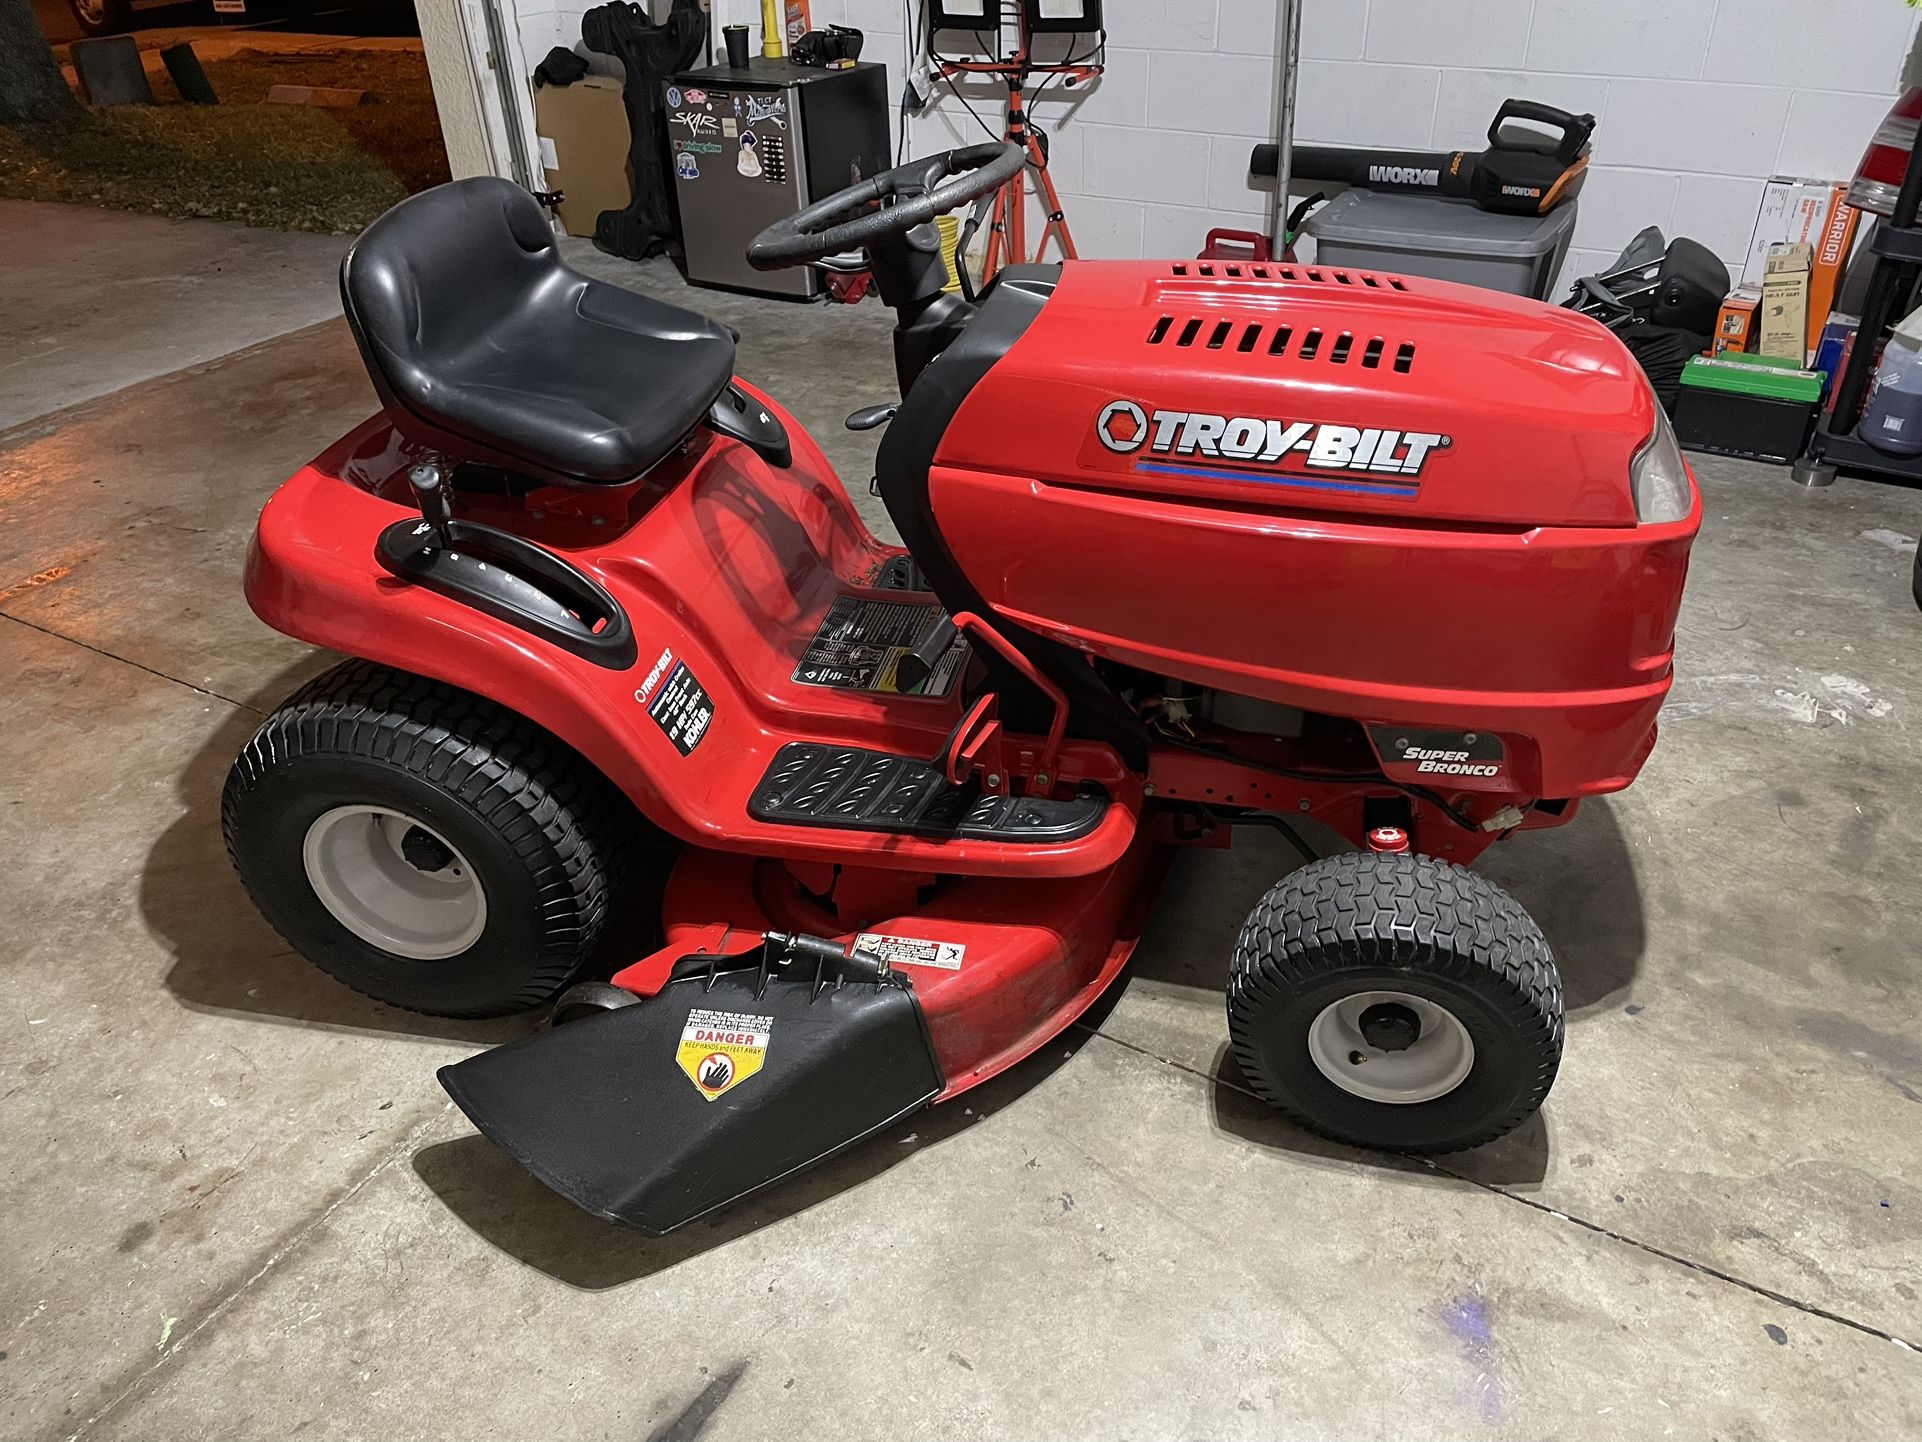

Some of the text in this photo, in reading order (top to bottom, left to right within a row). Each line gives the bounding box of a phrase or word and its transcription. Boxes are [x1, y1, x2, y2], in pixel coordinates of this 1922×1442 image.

[670, 112, 720, 137] SKAR
[1370, 166, 1439, 187] WORX
[1502, 185, 1540, 198] WORX
[1152, 409, 1441, 475] TROY-BILT
[640, 647, 673, 695] TROY-BILT
[682, 707, 711, 748] KOHLER
[1403, 747, 1469, 762] SUPER
[1417, 761, 1498, 776] BRONCO
[695, 1030, 755, 1045] DANGER
